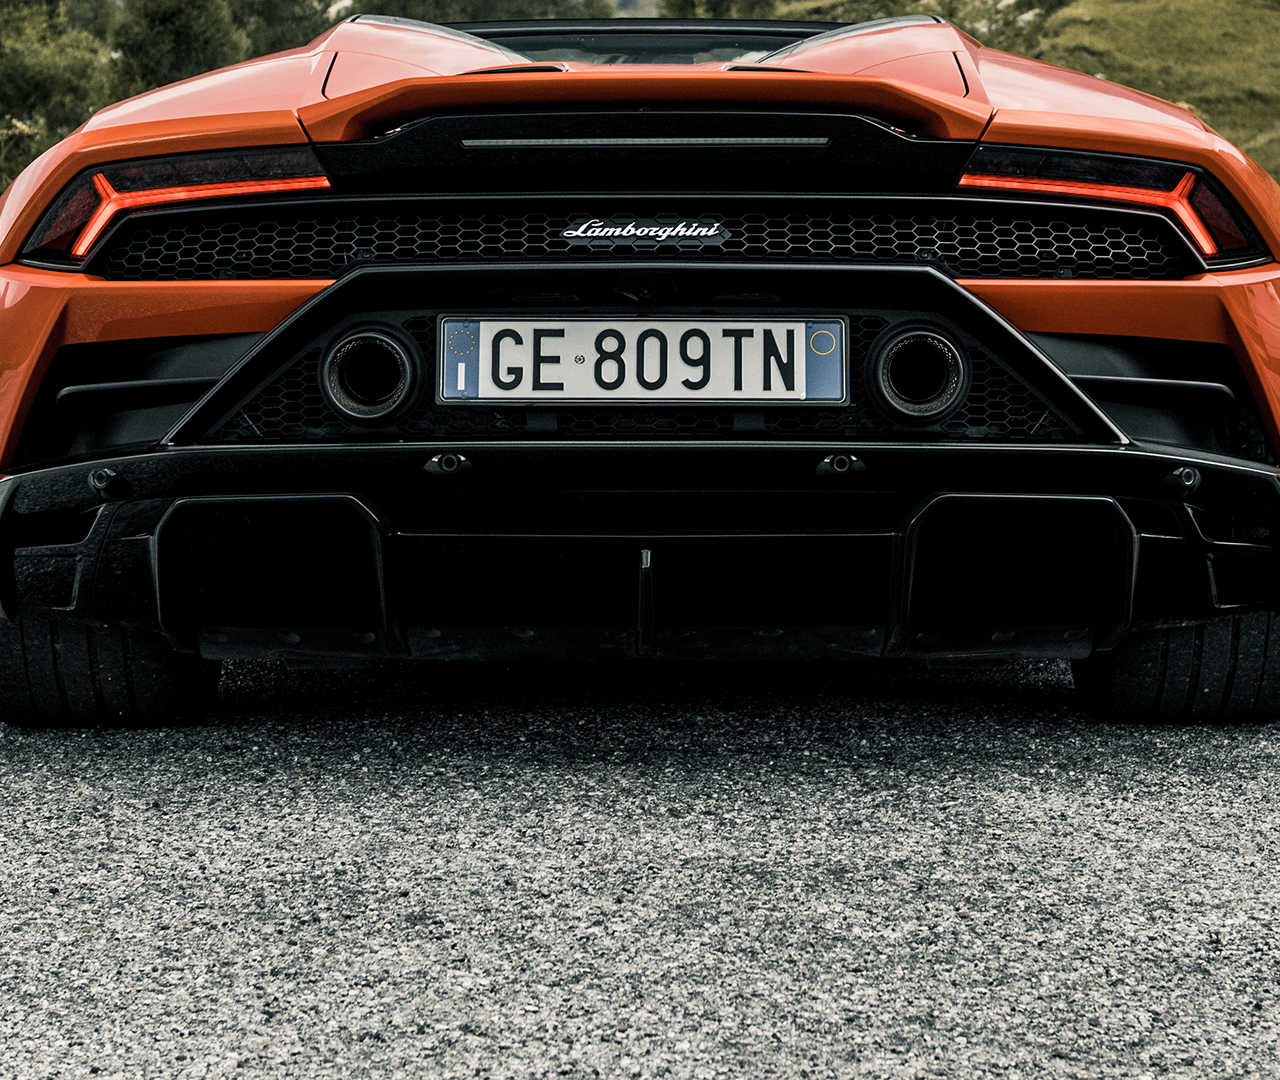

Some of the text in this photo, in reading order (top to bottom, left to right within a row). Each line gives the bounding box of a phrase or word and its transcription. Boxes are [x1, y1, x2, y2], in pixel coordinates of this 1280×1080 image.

[563, 219, 720, 241] Lamborghini
[491, 328, 795, 391] GE 809TN
